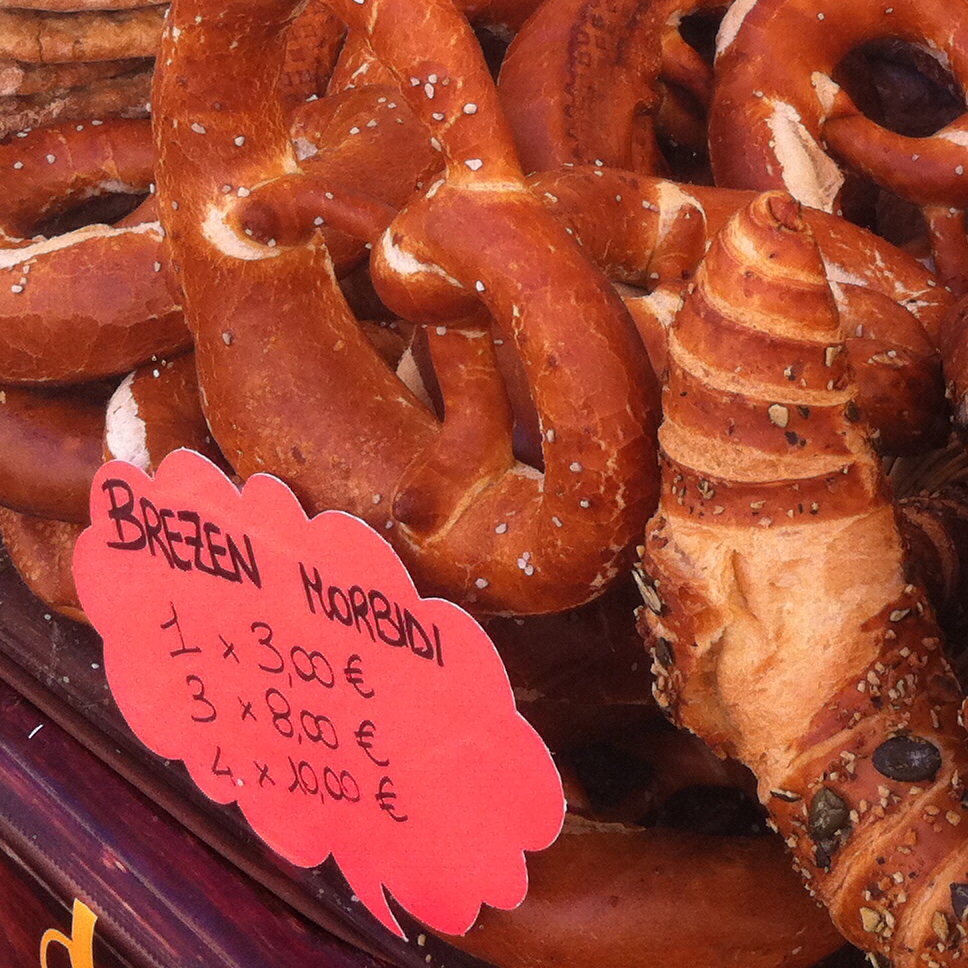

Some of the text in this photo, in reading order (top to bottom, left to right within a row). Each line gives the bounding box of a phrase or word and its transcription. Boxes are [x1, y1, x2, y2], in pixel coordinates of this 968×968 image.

[101, 478, 445, 667] BREZEN MORBIDI
[160, 601, 202, 658] 1
[251, 621, 335, 688] 3,00
[186, 674, 217, 722] 3
[265, 688, 339, 750] 8,00
[288, 756, 361, 805] 10,00
